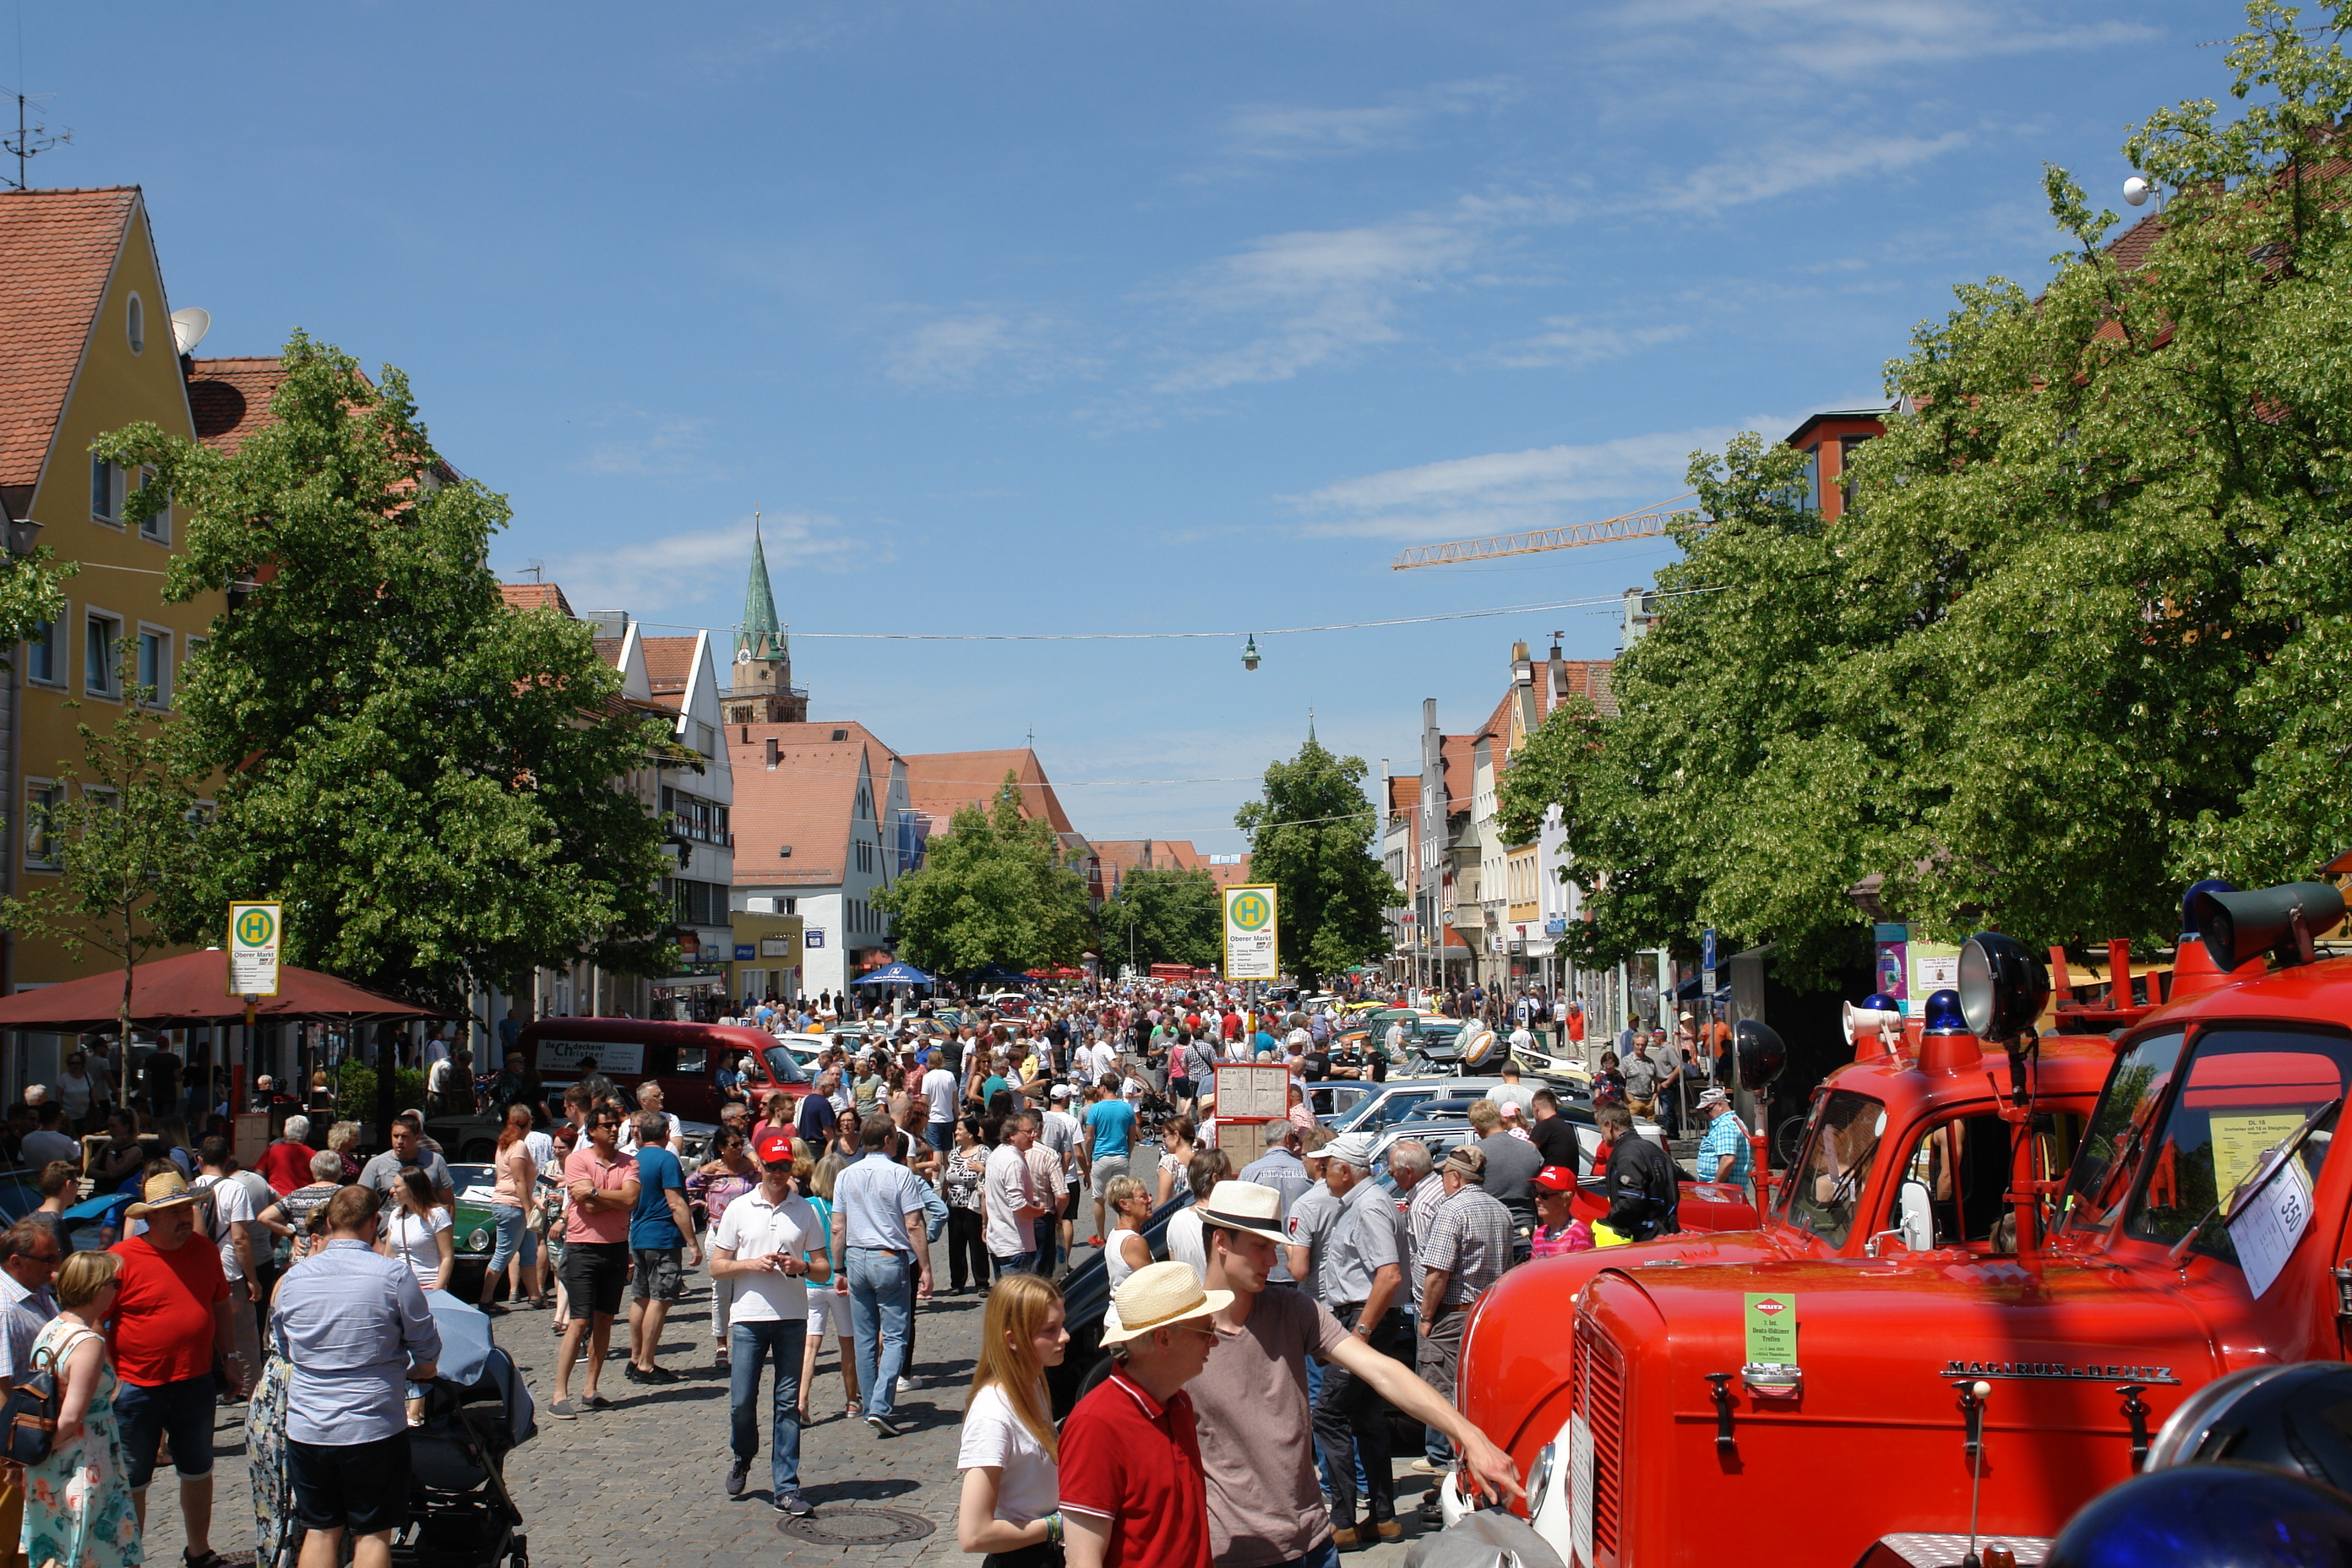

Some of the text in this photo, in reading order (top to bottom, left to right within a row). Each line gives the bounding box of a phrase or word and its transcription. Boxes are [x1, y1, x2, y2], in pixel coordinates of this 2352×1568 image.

[1241, 901, 1259, 922] H
[246, 917, 264, 938] H
[1705, 935, 1712, 965] P
[2281, 1194, 2302, 1233] 350
[1947, 1360, 2172, 1379] MAGIRUS-DEUTZ
